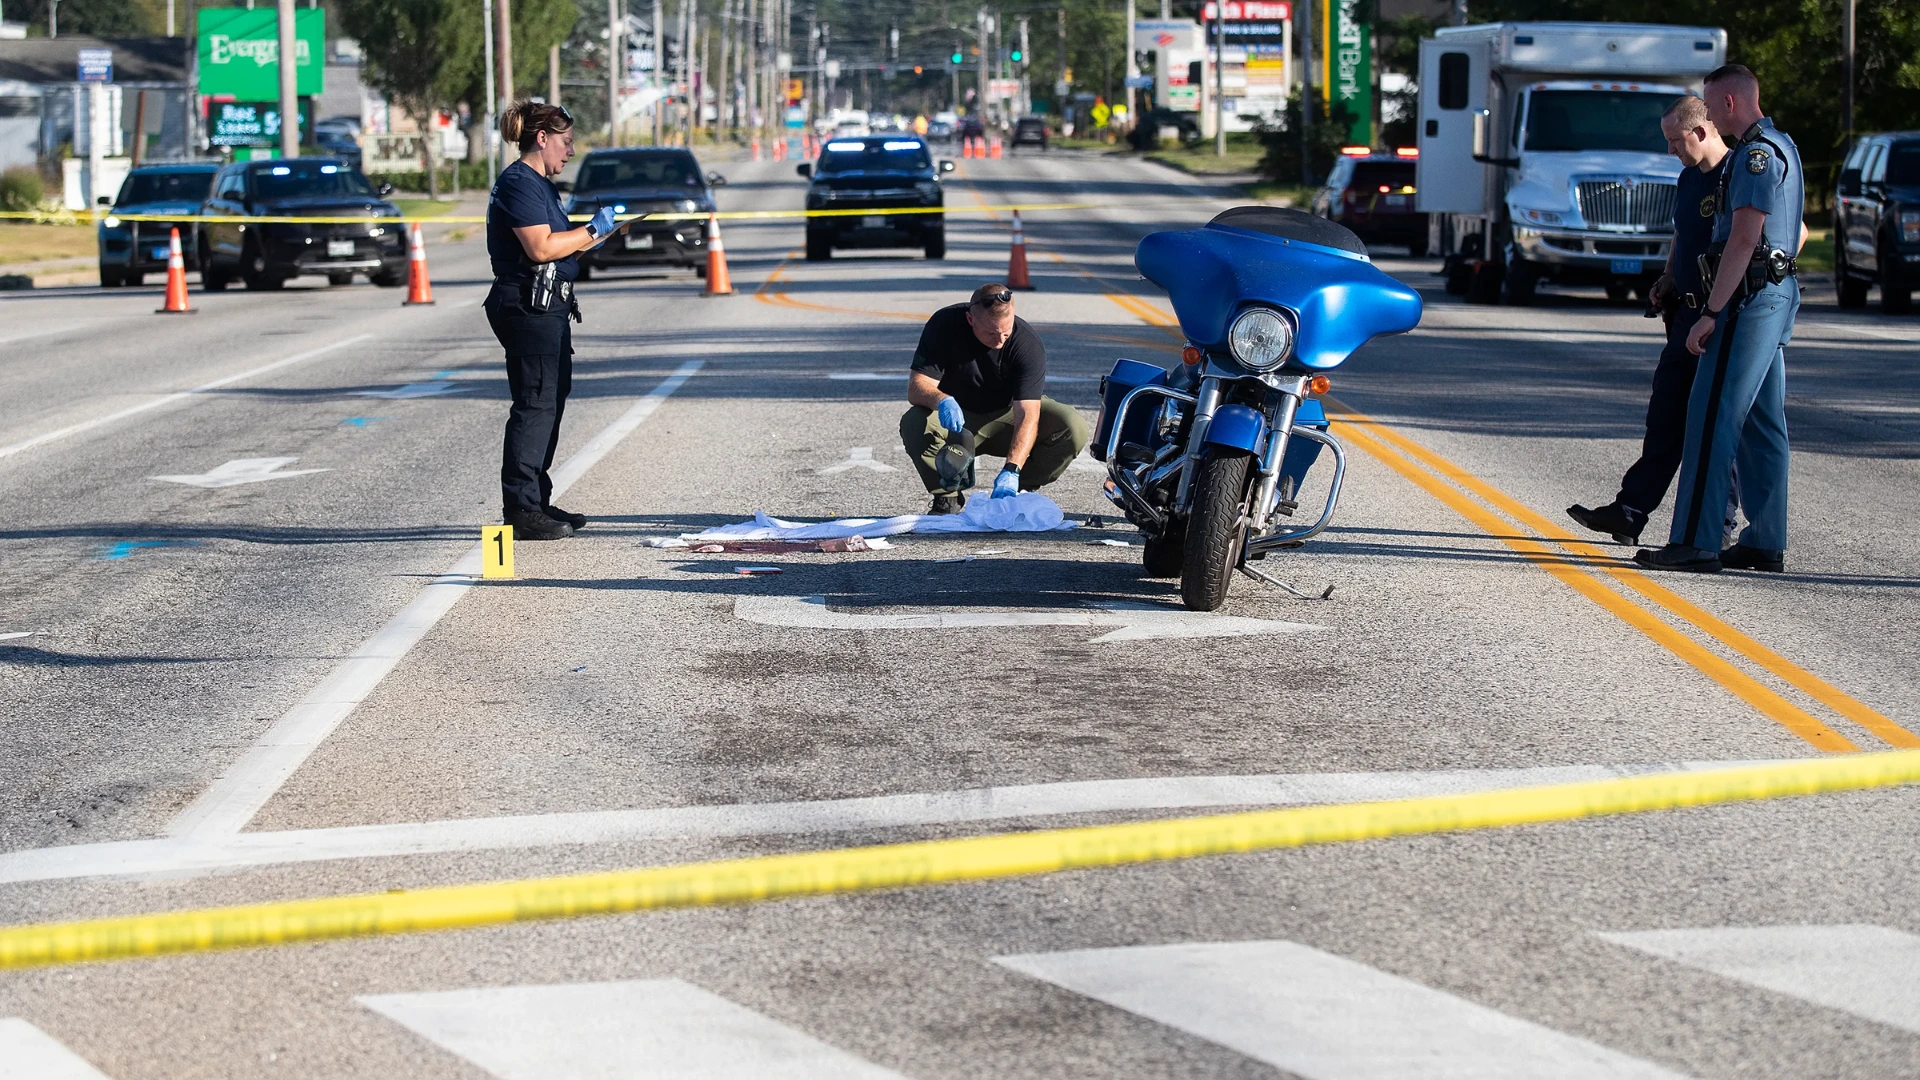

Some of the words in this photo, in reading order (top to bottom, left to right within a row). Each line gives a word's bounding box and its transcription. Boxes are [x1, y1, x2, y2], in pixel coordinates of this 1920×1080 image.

[209, 34, 310, 67] Evergrn
[1338, 48, 1361, 100] Bank
[493, 530, 504, 566] 1
